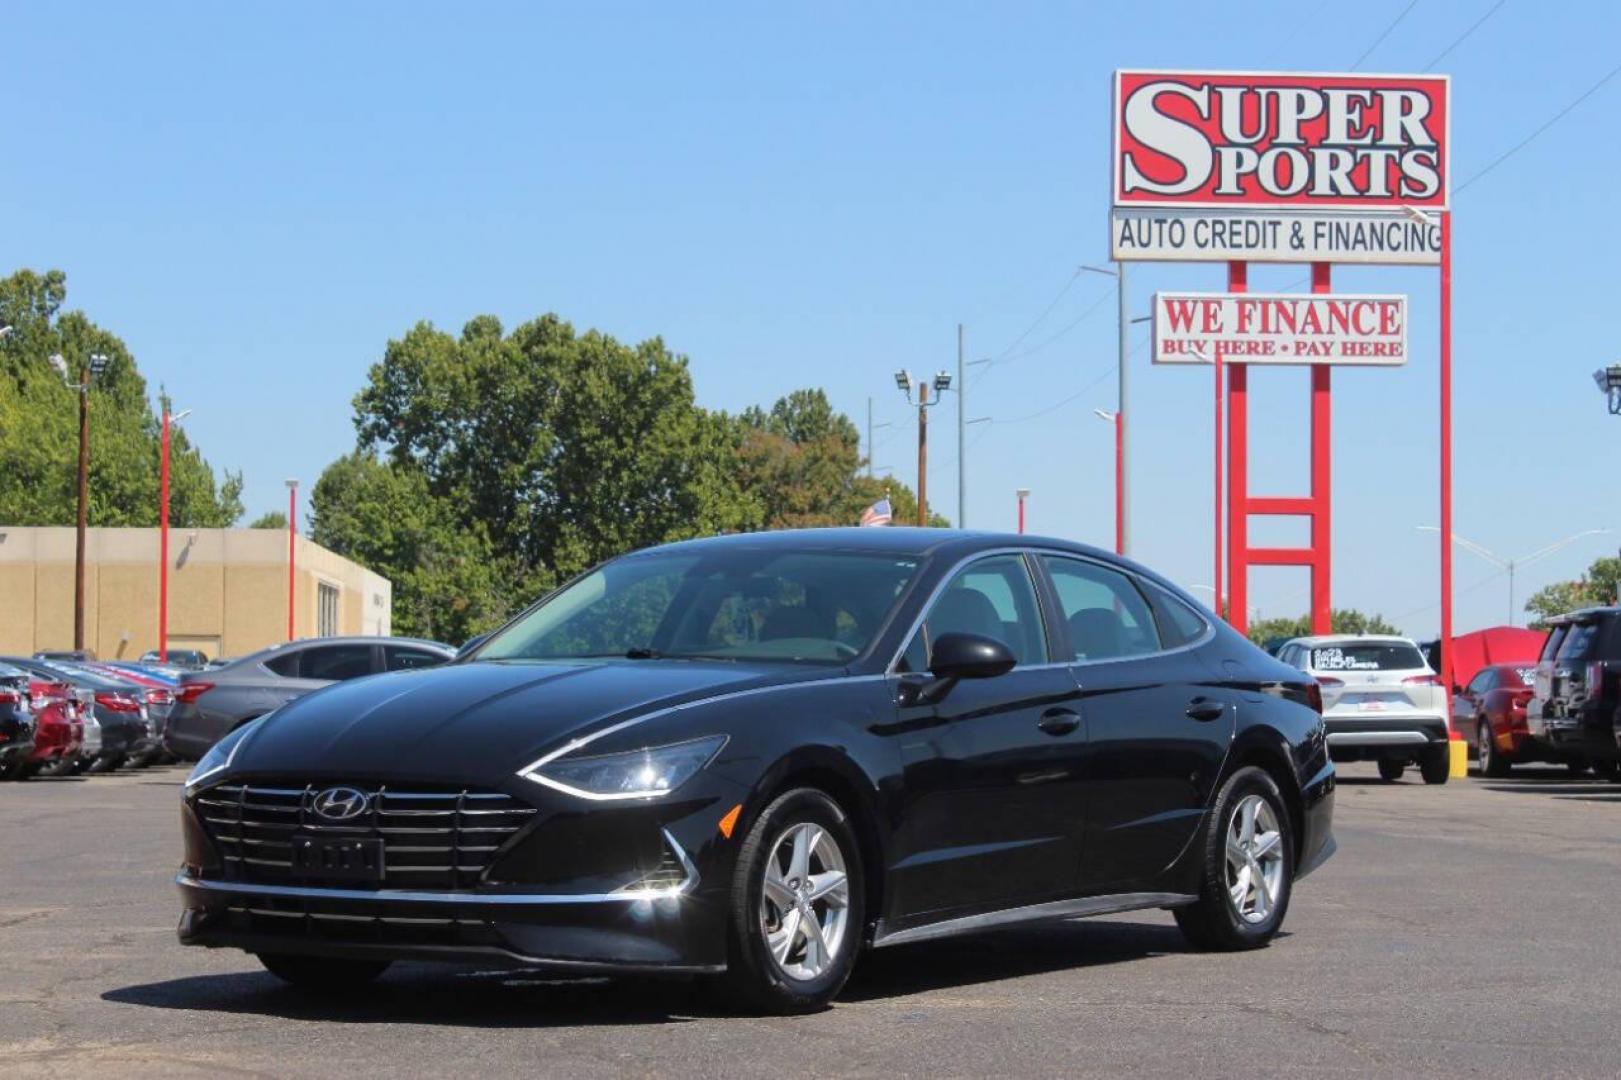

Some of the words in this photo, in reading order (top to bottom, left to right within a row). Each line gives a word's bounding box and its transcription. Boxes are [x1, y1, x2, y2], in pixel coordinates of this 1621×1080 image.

[1119, 218, 1185, 248] AUTO
[1193, 220, 1281, 249] CREDIT
[1290, 223, 1304, 249] &
[1164, 300, 1223, 334] WE
[1236, 300, 1401, 335] FINANCE
[1163, 341, 1207, 355] BUY
[1215, 341, 1275, 355] HERE
[1295, 341, 1333, 356] PAY
[1341, 342, 1402, 357] HERE
